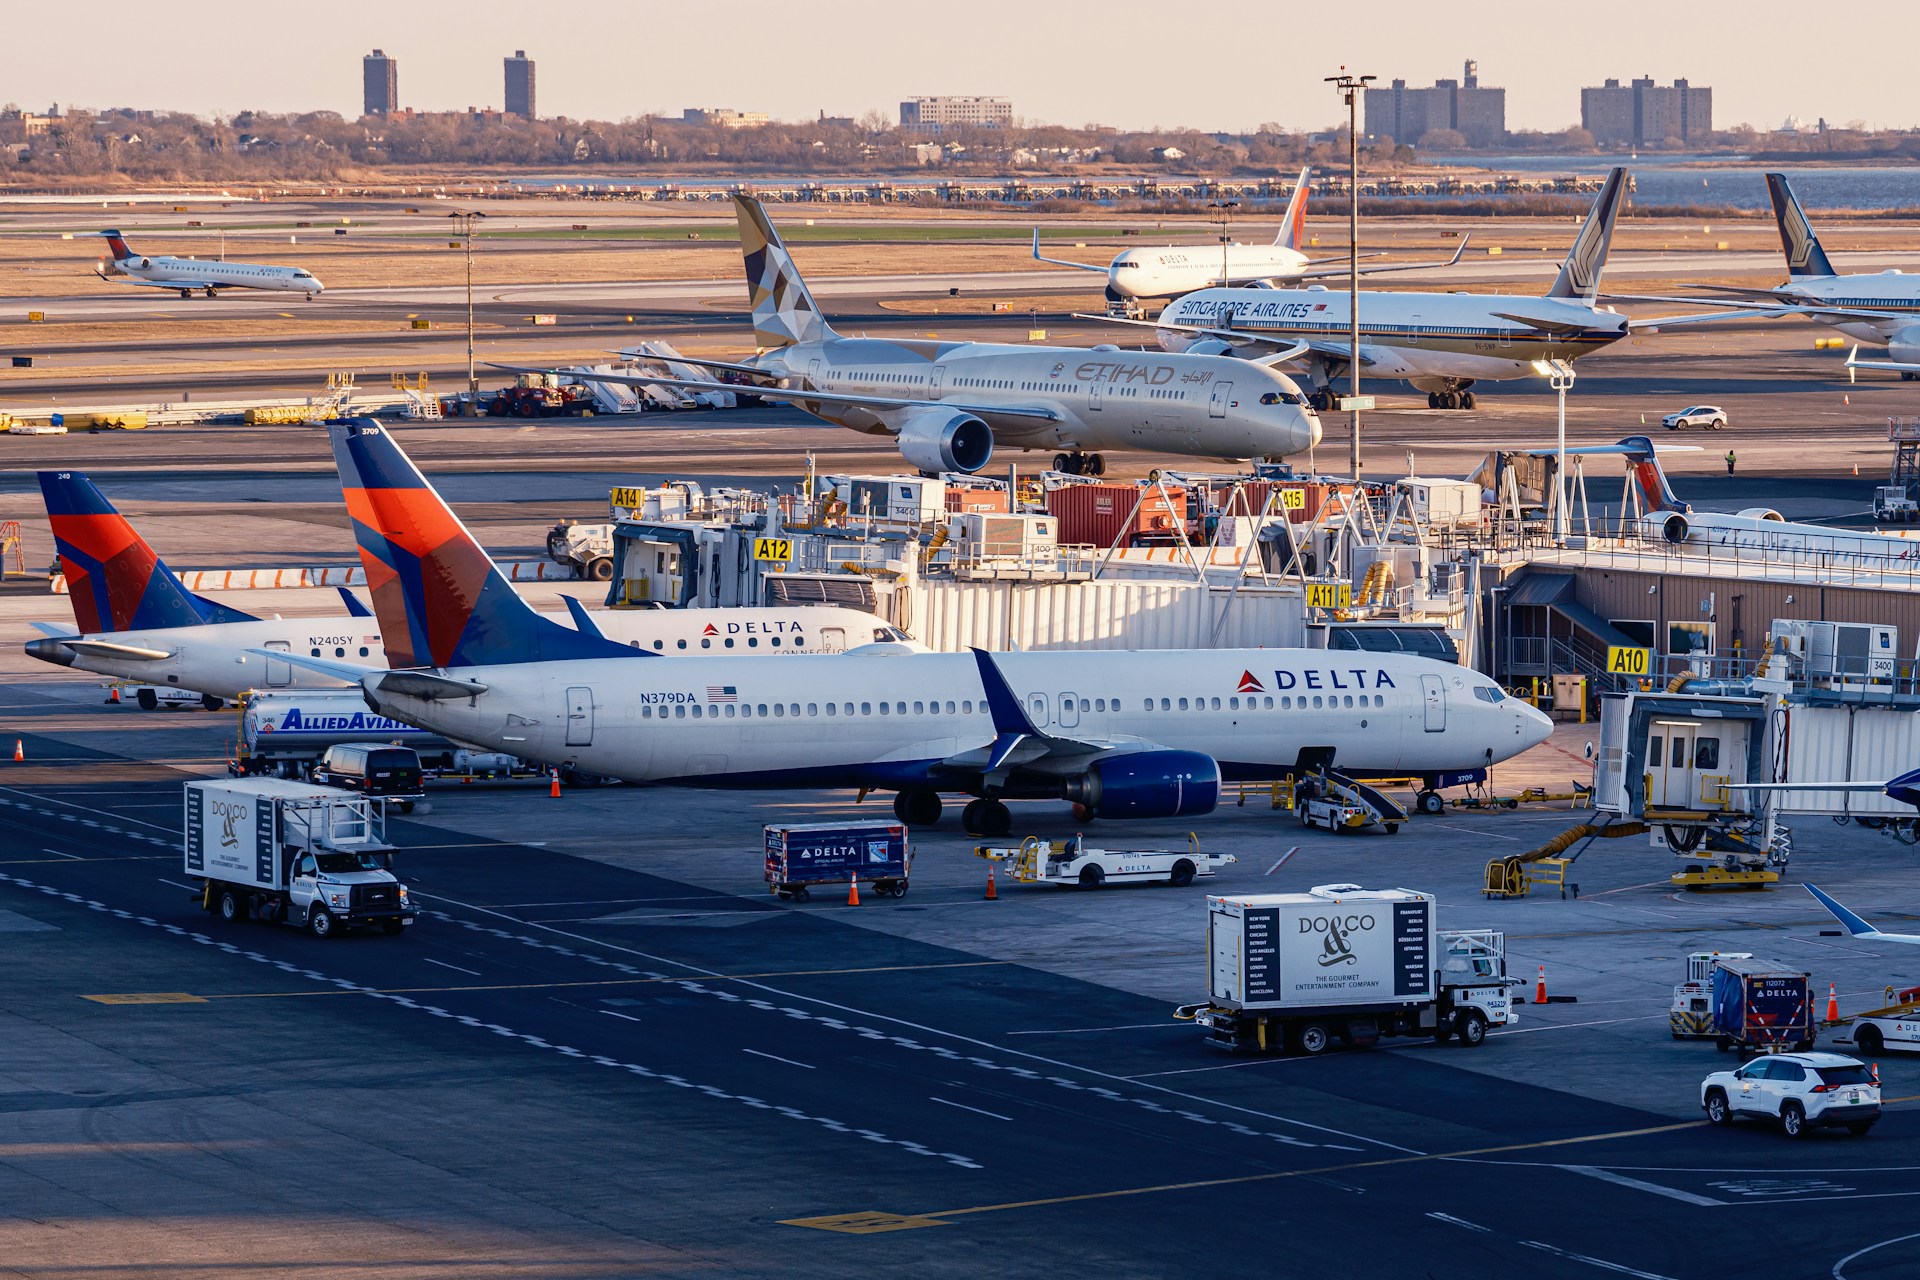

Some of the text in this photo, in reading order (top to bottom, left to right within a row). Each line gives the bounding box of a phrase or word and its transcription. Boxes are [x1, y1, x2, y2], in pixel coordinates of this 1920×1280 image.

[1165, 255, 1189, 264] DELTA
[1179, 300, 1312, 318] SINGAPORE AIRLINES
[1075, 362, 1175, 385] ETIHAD
[1364, 399, 1373, 407] 62
[361, 428, 380, 436] 3709
[615, 488, 637, 506] A14
[1282, 491, 1301, 508] A15
[758, 540, 788, 559] A12
[1312, 586, 1333, 607] A11
[1339, 587, 1350, 607] A11
[728, 621, 803, 634] DELTA
[309, 636, 353, 646] N240SY
[1613, 648, 1644, 673] A10
[1874, 661, 1892, 671] 3400
[1275, 670, 1396, 690] DELTA
[641, 692, 696, 704] N379DA
[281, 708, 421, 730] ALLIED AVIA
[1457, 774, 1473, 782] 3709
[815, 847, 856, 857] DELTA
[1299, 915, 1375, 967] DO&CO
[1328, 974, 1360, 982] GOURMET
[1349, 981, 1380, 989] COMPANY
